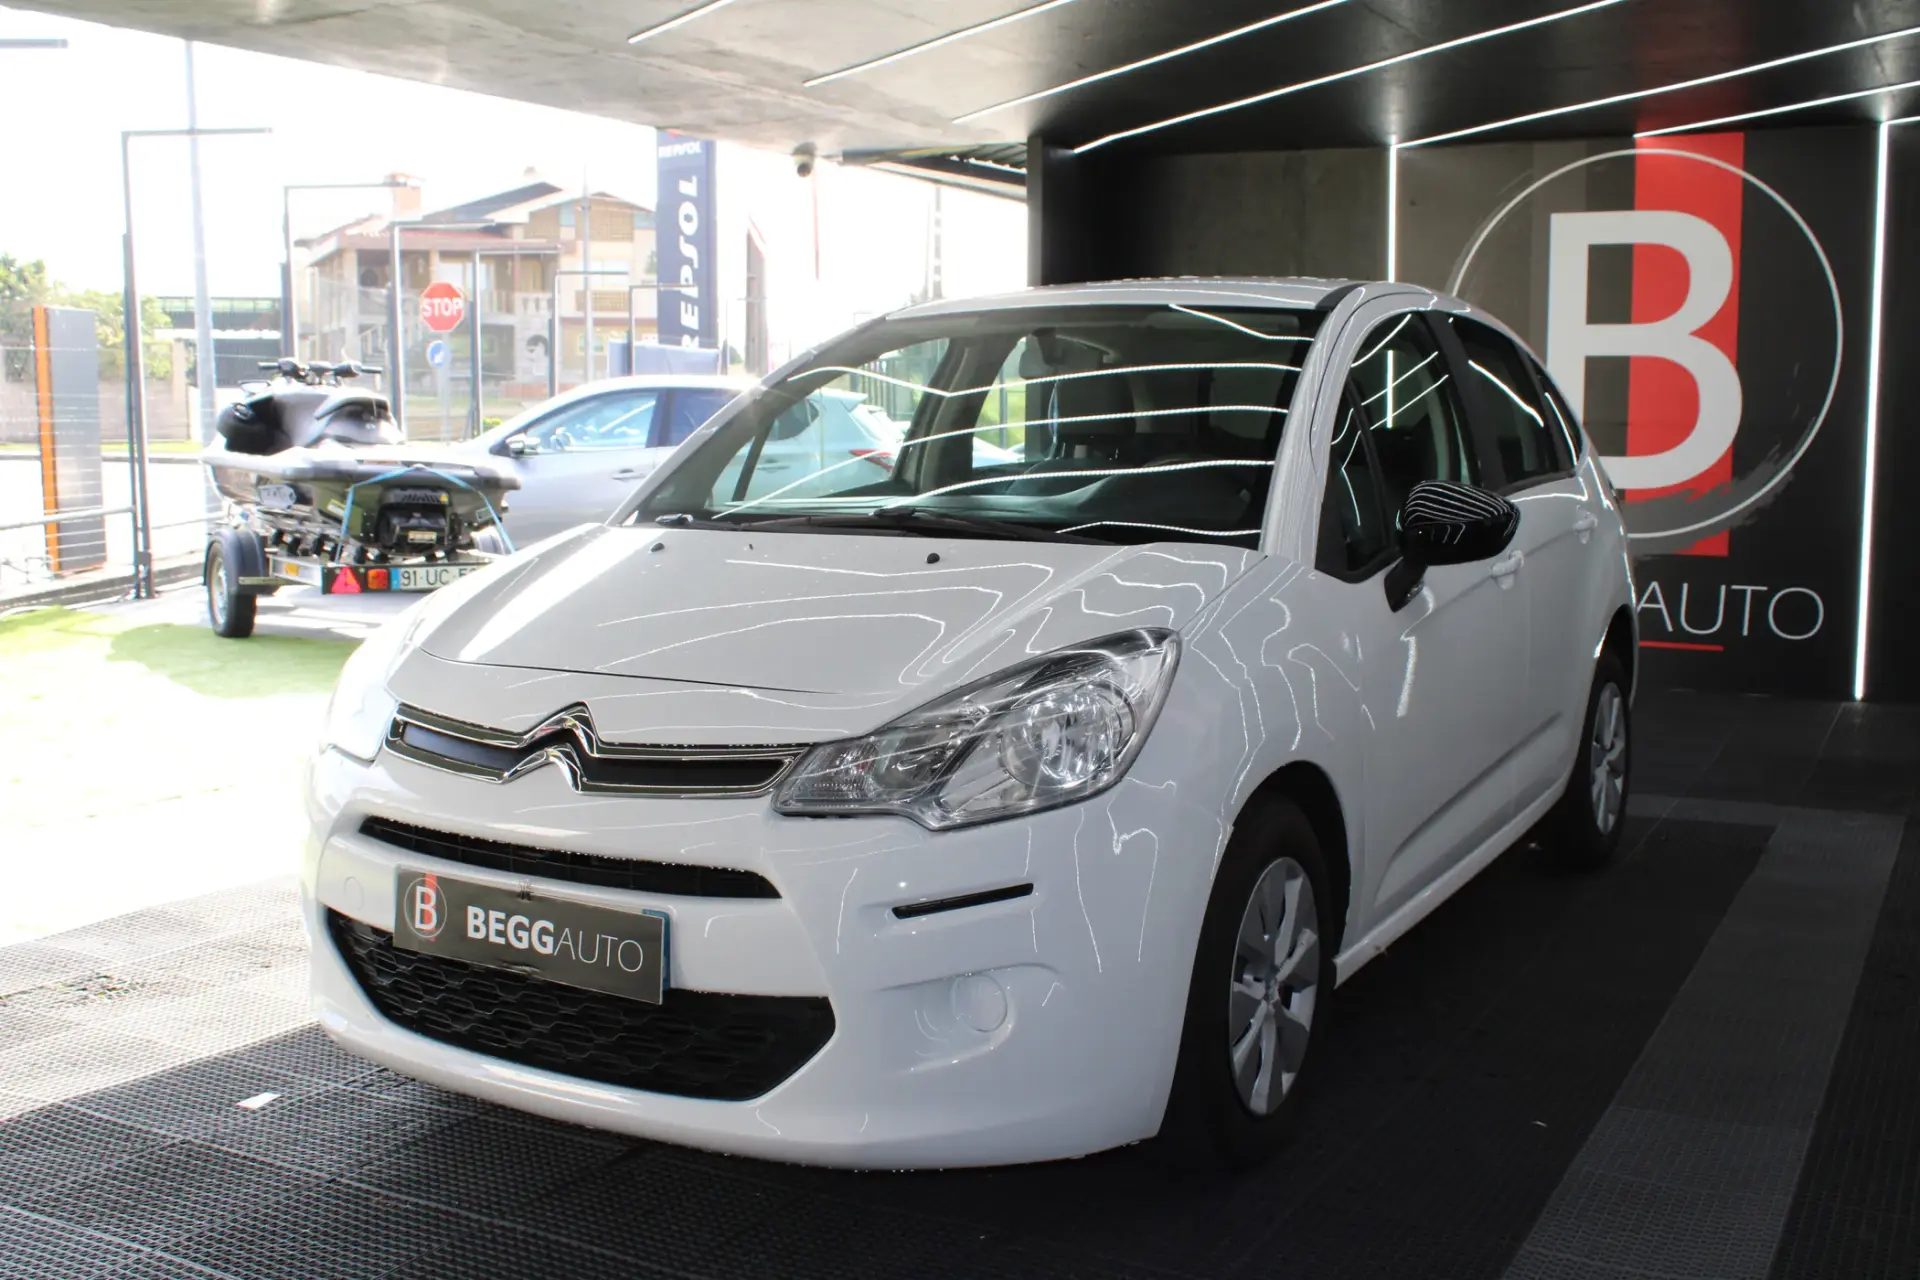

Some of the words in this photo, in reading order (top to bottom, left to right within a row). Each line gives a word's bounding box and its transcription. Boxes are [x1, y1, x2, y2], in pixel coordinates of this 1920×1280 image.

[423, 297, 463, 317] STOP
[1547, 209, 1743, 490] B
[414, 885, 438, 931] B
